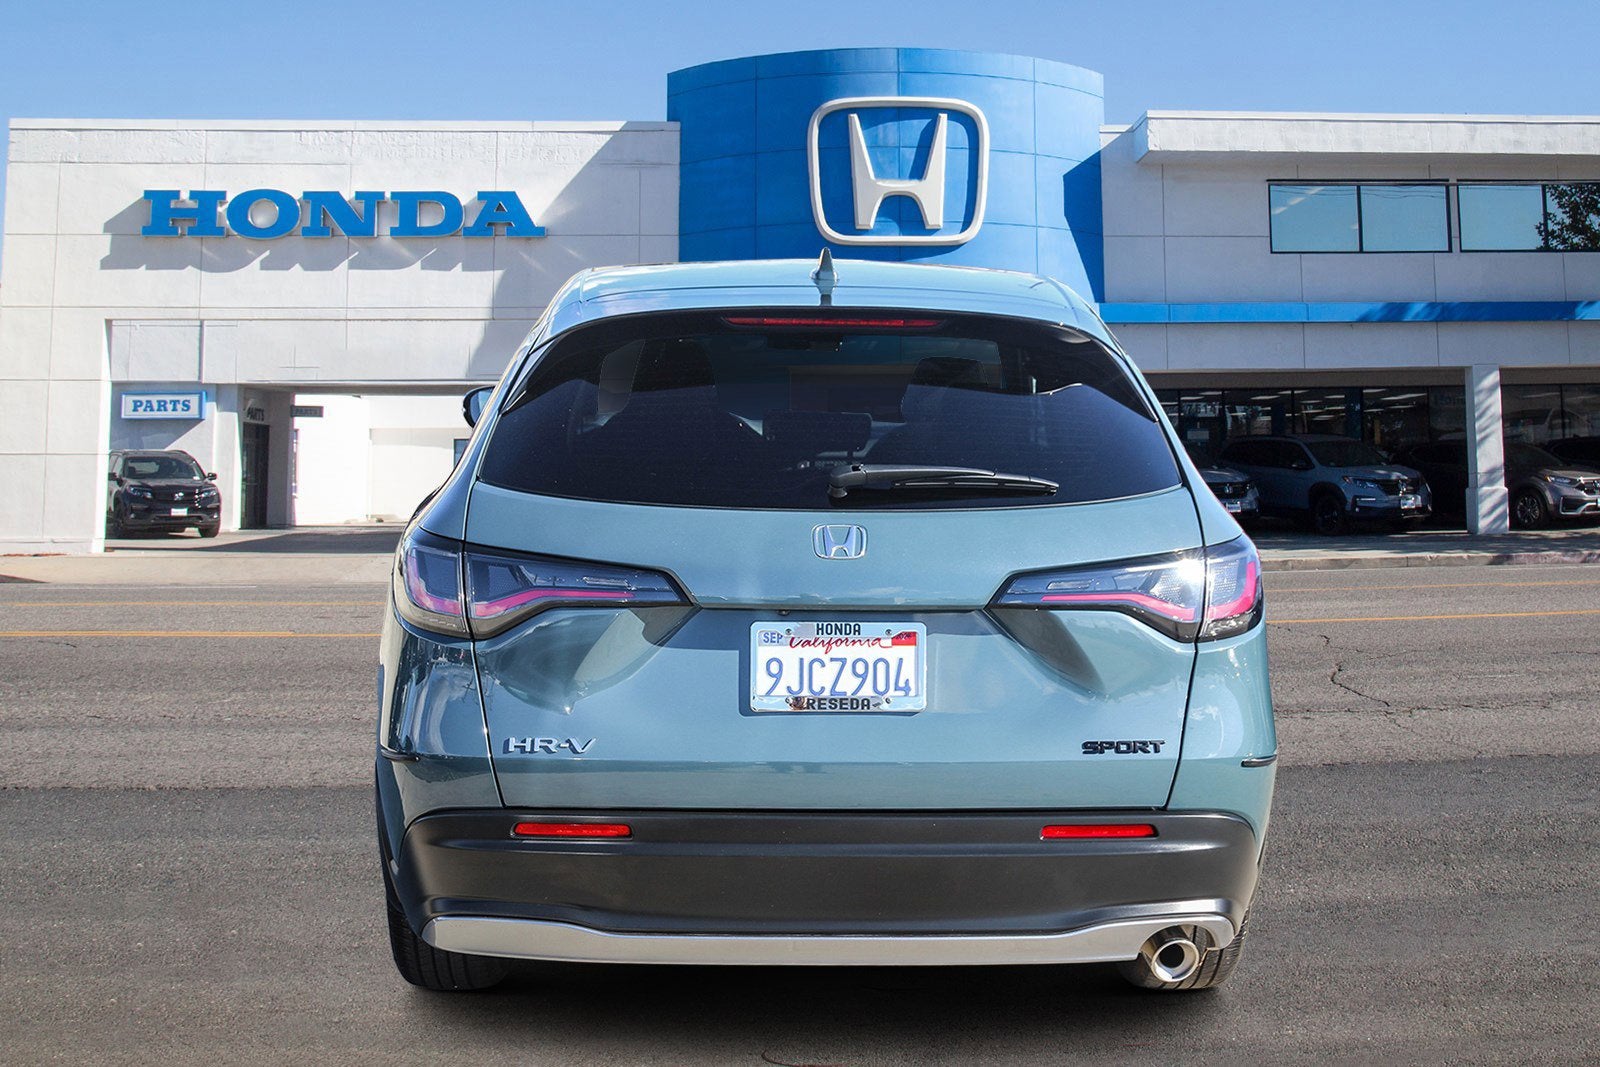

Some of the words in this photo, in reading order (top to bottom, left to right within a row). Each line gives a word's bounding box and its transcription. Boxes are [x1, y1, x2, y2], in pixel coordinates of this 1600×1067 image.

[140, 188, 547, 240] HONDA
[131, 399, 191, 412] PARTS
[816, 622, 861, 636] HONDA
[763, 632, 784, 644] SEP
[789, 636, 893, 654] California
[765, 657, 912, 696] 9JCZ904
[806, 698, 871, 710] RESEDA
[502, 737, 597, 754] HR-V
[1081, 740, 1166, 755] SPORT
